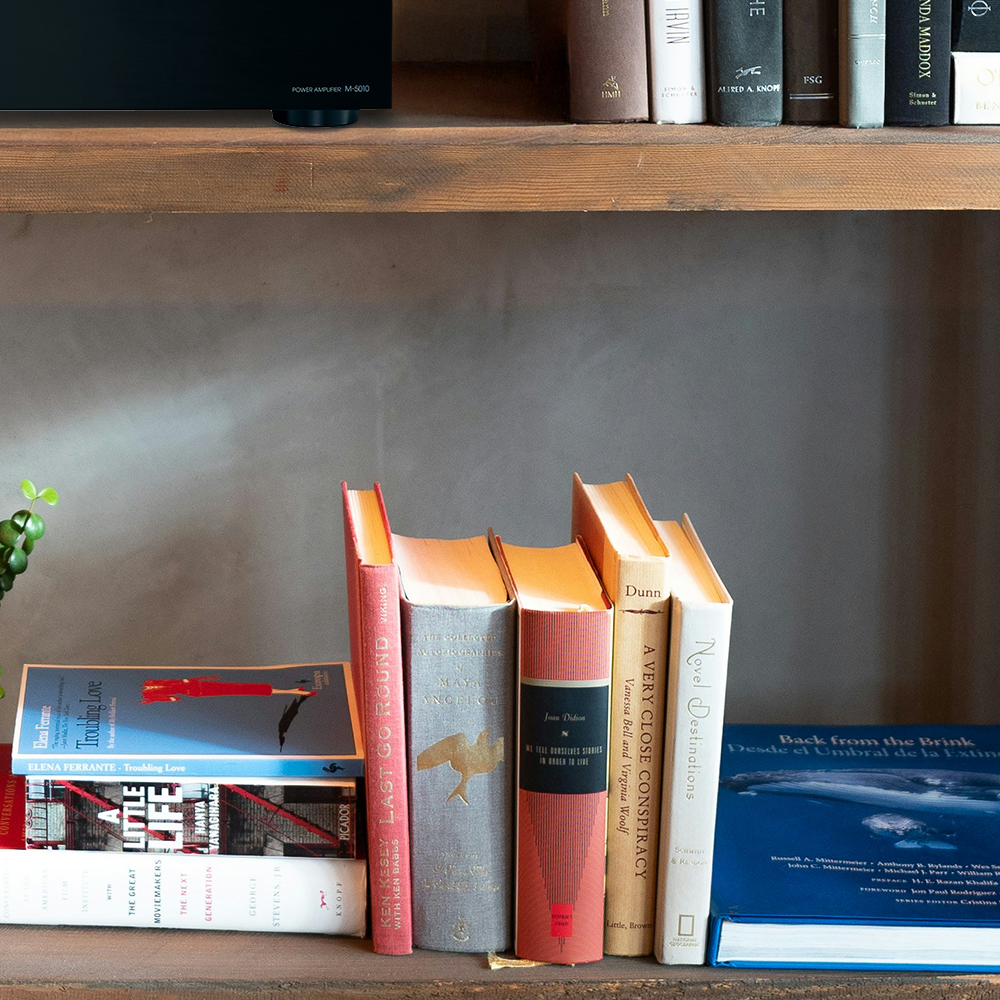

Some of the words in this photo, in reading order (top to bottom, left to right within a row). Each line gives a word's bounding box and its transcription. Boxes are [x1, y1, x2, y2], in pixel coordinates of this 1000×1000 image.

[665, 7, 690, 45] IRVIN
[918, 25, 932, 79] MADDOX
[291, 86, 314, 94] POWER
[344, 84, 371, 93] M-5010
[717, 85, 745, 93] ALFRED
[756, 83, 781, 93] KNOPF
[803, 75, 823, 84] FSG
[379, 586, 388, 624] VIKING
[625, 584, 662, 599] Dunn
[643, 644, 656, 656] A
[686, 636, 717, 689] Novel
[79, 680, 103, 703] Love
[375, 635, 391, 717] ROUND
[438, 677, 481, 688] MAYA
[641, 660, 656, 705] VERY
[422, 695, 499, 706] ANGELOU
[622, 677, 635, 716] Vanessa
[75, 704, 107, 750] Troubling
[377, 725, 392, 759] GO
[621, 718, 634, 739] Bell
[639, 708, 654, 764] CLOSE
[778, 733, 829, 746] Back
[830, 734, 880, 747] from
[882, 735, 916, 748] the
[918, 736, 977, 748] Brink
[550, 746, 581, 756] OURSELVES
[582, 745, 604, 755] STORIES
[621, 740, 633, 761] and
[685, 696, 711, 802] Destinations
[727, 743, 790, 755] Desde
[793, 745, 811, 756] el
[813, 746, 890, 758] Umbral
[894, 747, 918, 758] de
[919, 747, 941, 758] la
[27, 763, 61, 773] ELENA
[64, 763, 116, 773] FERRANTE
[123, 763, 163, 774] Troubling
[165, 763, 186, 773] Love
[617, 763, 632, 802] Virginia
[379, 766, 395, 825] LAST
[97, 808, 120, 825] A
[122, 785, 146, 850] LITTLE
[147, 785, 183, 851] LIFE
[194, 800, 206, 835] HANYA
[208, 783, 220, 850] YANAGIHARA
[338, 803, 350, 841] PICADOR
[616, 804, 630, 836] Woolf
[634, 769, 651, 880] CONSPIRACY
[379, 838, 391, 889] KESEY
[770, 855, 802, 863] Russell
[815, 856, 868, 866] Mittermeier
[876, 861, 915, 869] Anthony
[822, 863, 875, 873] Mittermeier
[884, 867, 920, 875] Michael
[128, 867, 137, 897] GREAT
[153, 858, 163, 925] MOVIEMAKERS
[180, 872, 188, 897] NEXT
[204, 865, 213, 922] GENERATION
[393, 877, 402, 900] KEN
[128, 899, 136, 916] THE
[180, 899, 188, 915] THE
[335, 881, 343, 917] KNOPF
[379, 894, 392, 929] KEN
[960, 898, 998, 906] Cristina
[393, 902, 403, 930] WITH
